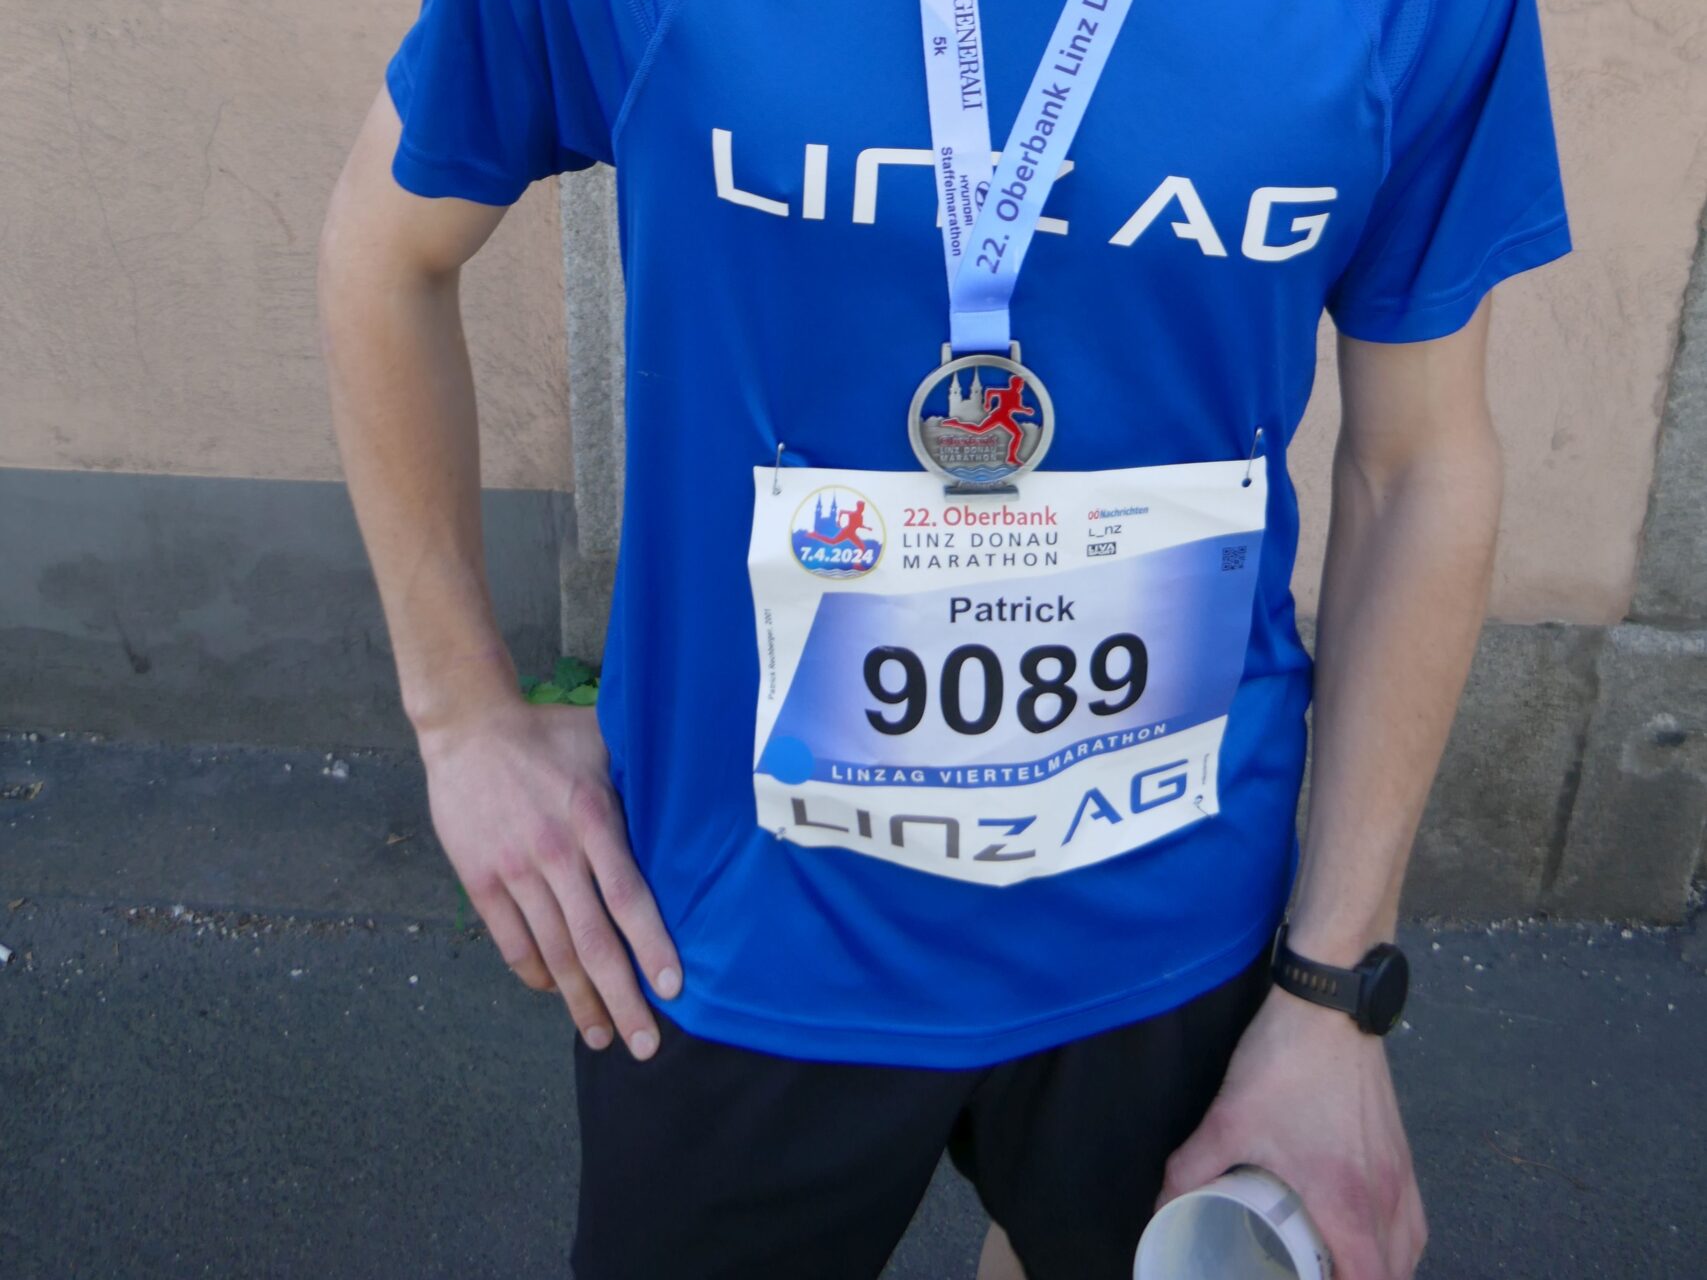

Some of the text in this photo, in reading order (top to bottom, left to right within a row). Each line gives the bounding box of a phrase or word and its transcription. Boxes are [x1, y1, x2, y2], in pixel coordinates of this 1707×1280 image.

[933, 36, 948, 56] 5k
[976, 234, 1010, 274] 22.
[996, 82, 1071, 222] Oberbank
[1055, 18, 1098, 78] Linz
[941, 146, 962, 257] Staffelmarathon
[960, 174, 973, 226] HYUNDAI
[1108, 175, 1338, 262] AG
[939, 454, 997, 462] MARATHON
[903, 505, 1058, 527] 22. Oberbank
[800, 546, 874, 564] 7.4.2024
[903, 531, 1058, 548] LINZ DONAU
[903, 551, 1058, 569] MARATHON
[949, 595, 1075, 623] Patrick
[863, 632, 1149, 736] 9089
[940, 723, 1166, 784] VIERTELMARATHON
[790, 798, 1038, 862] LINZ
[1060, 758, 1189, 848] AG
